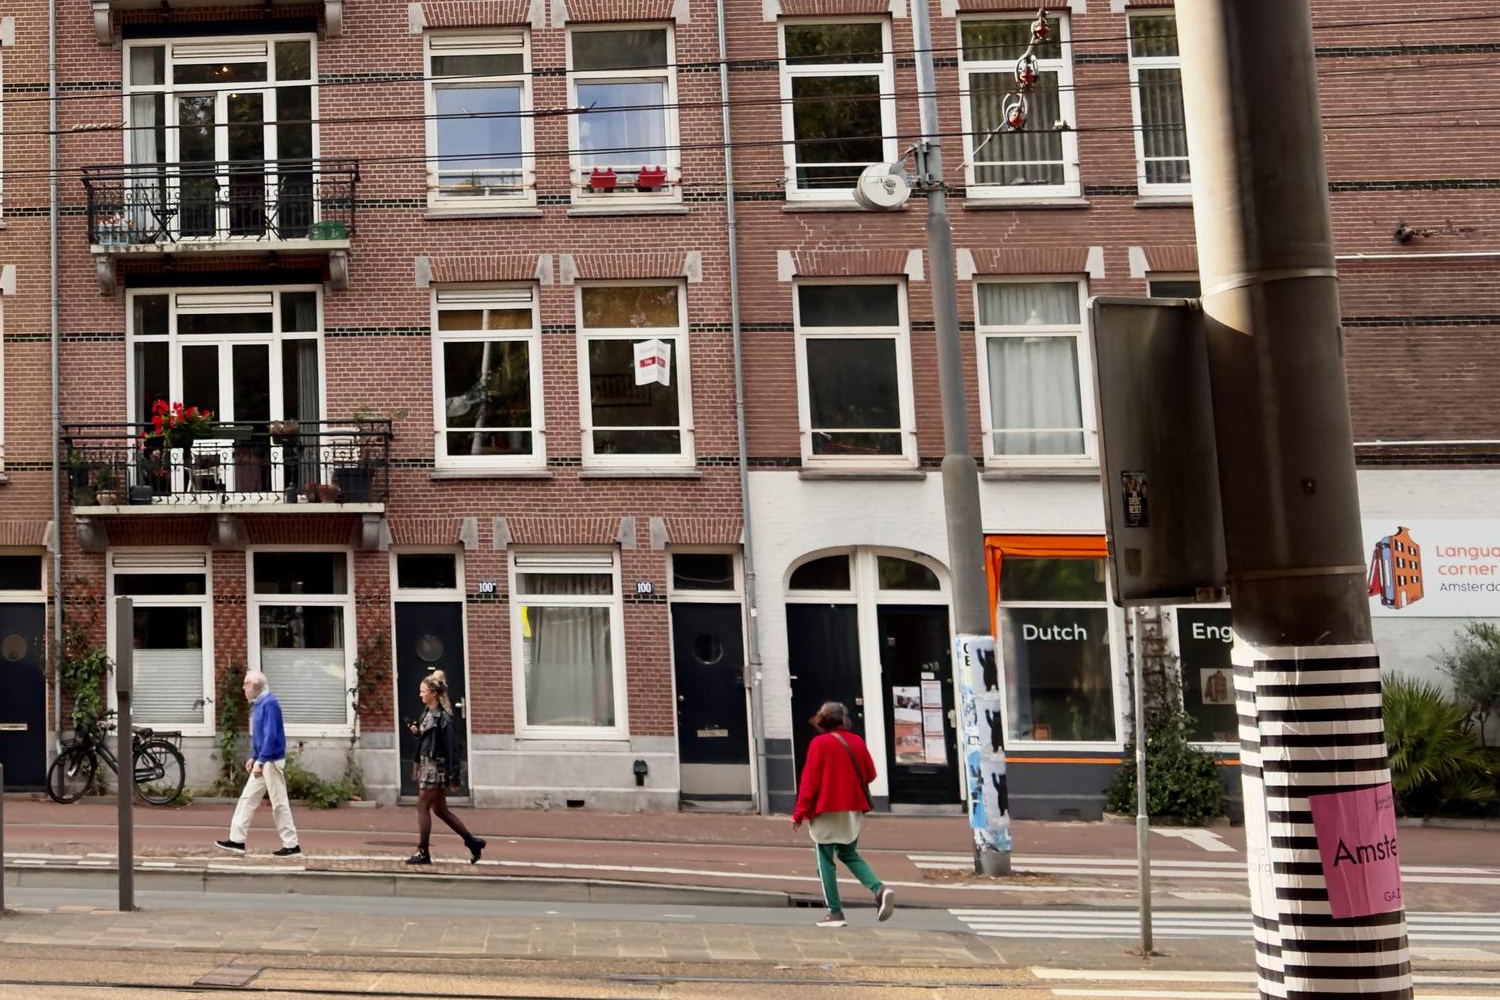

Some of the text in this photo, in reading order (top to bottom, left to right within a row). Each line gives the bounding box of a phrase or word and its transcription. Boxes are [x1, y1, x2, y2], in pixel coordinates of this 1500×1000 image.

[1437, 564, 1498, 576] corner
[637, 582, 651, 593] 100
[1022, 624, 1088, 641] Dutch
[1192, 623, 1234, 642] Eng
